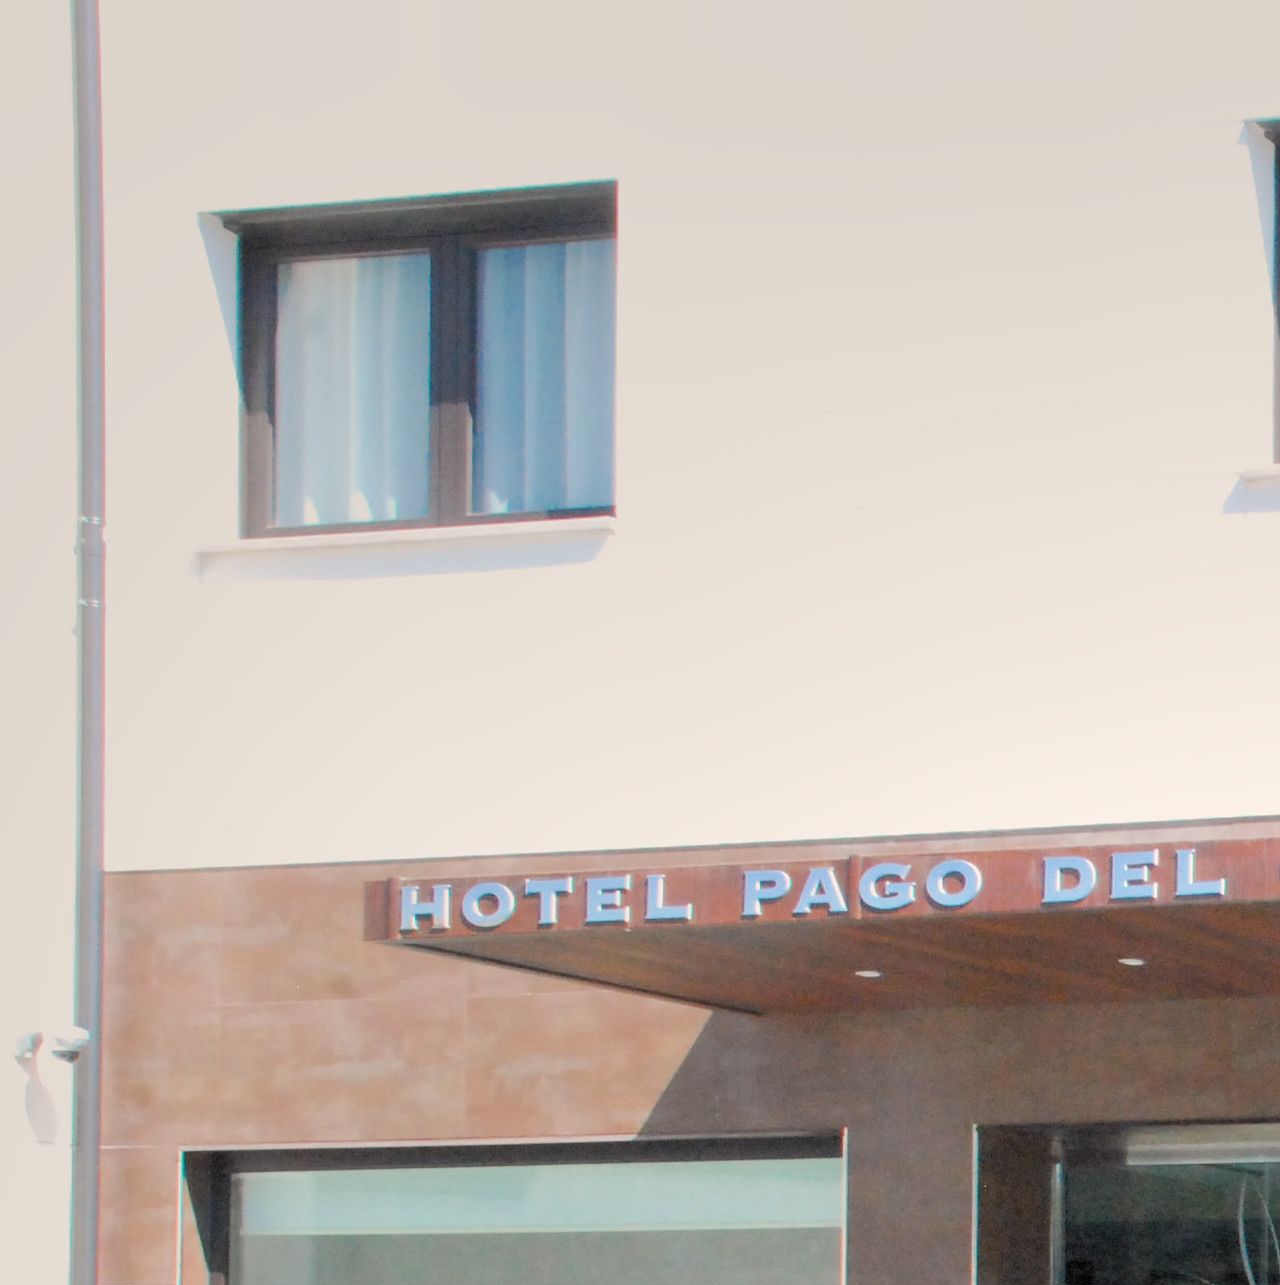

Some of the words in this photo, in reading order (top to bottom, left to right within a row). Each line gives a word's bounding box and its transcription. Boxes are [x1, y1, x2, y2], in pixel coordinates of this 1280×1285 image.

[400, 874, 693, 931] HOTEL
[741, 859, 983, 917] PAGO
[1041, 848, 1226, 904] DEL
